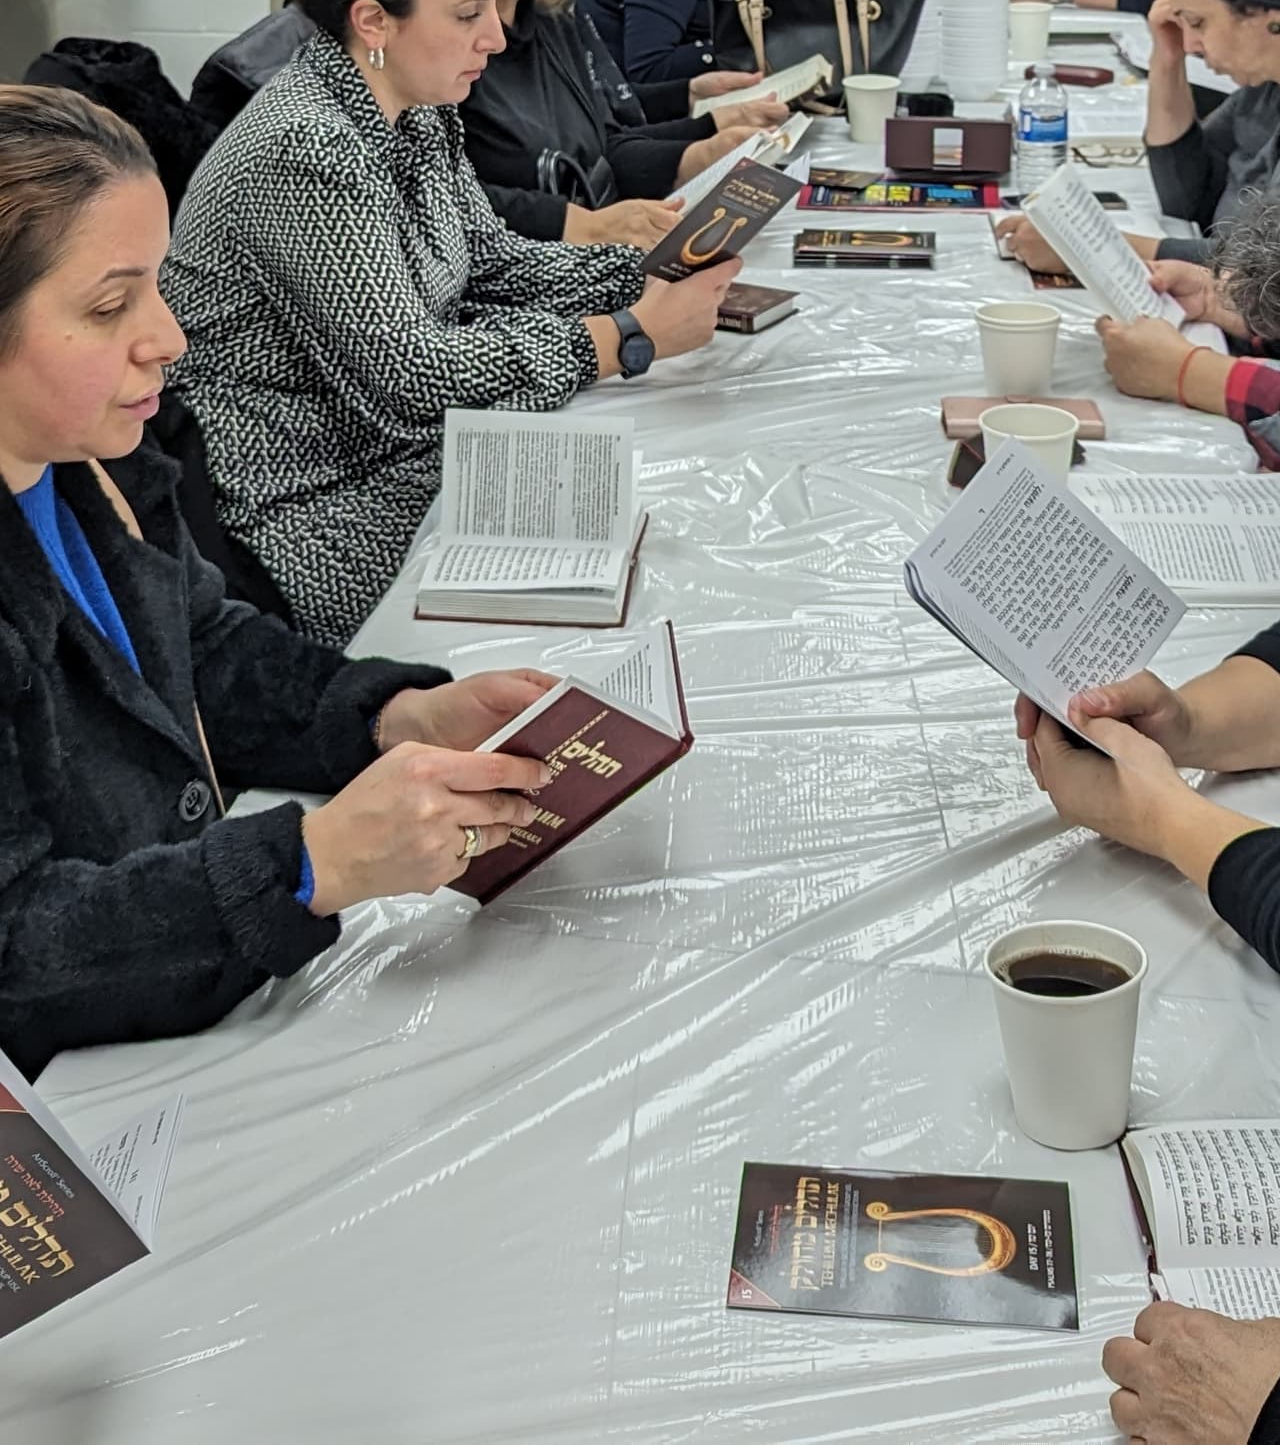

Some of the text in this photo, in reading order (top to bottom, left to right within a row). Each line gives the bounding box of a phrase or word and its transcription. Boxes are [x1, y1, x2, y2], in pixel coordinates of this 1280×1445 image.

[562, 739, 623, 779] תהלים
[4, 1154, 26, 1174] שרה
[22, 1171, 43, 1193] לאה
[784, 1177, 821, 1228] תהלים
[824, 1182, 839, 1237] MECHULAK
[1028, 1247, 1038, 1256] 15
[1029, 1256, 1039, 1271] DAY
[742, 1289, 752, 1299] 15
